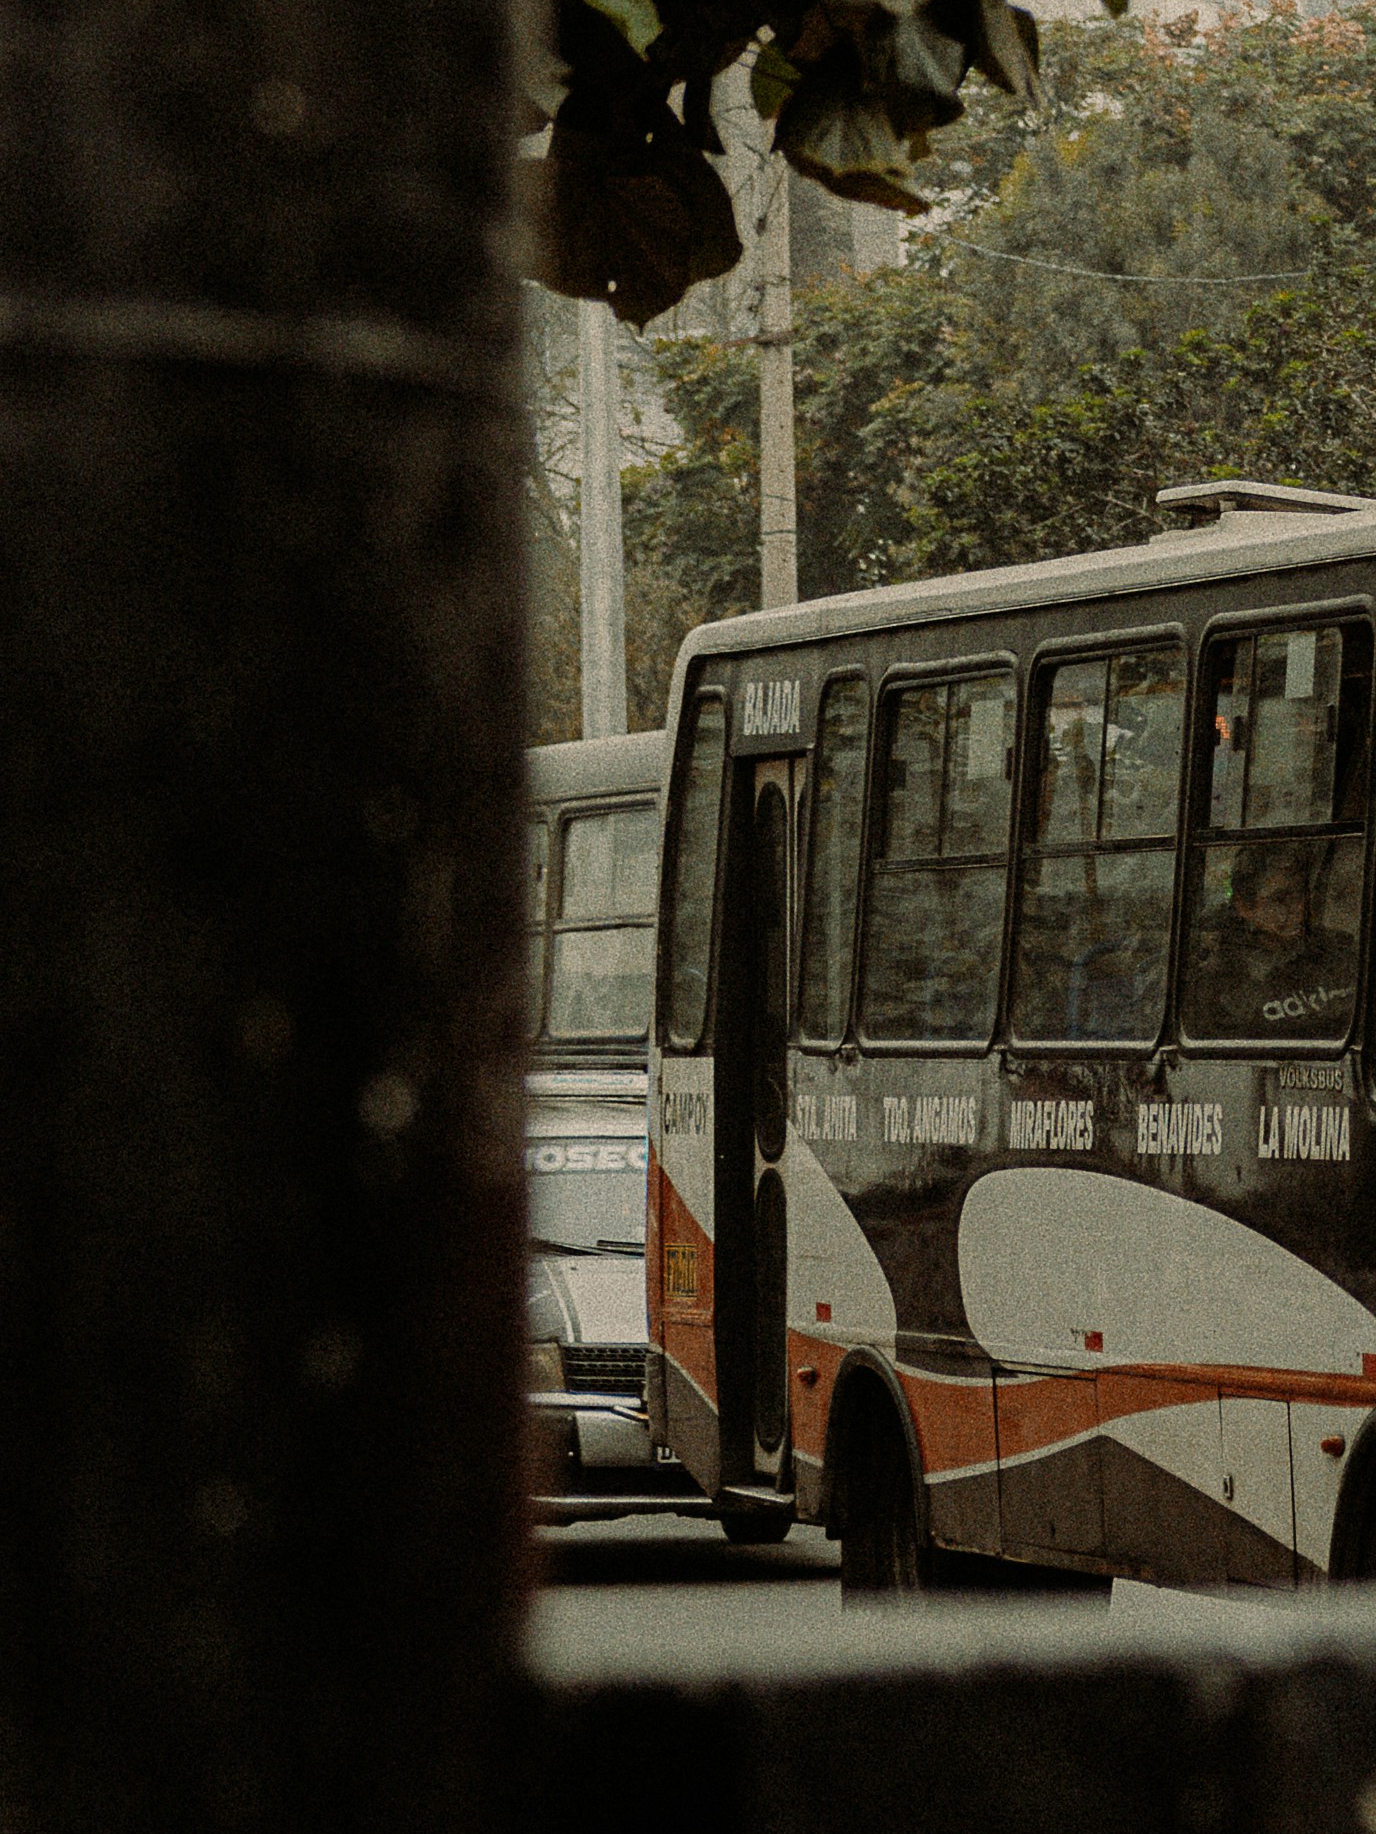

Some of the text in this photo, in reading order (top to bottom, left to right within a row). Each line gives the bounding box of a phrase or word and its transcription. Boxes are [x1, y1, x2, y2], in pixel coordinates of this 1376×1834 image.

[743, 680, 801, 736] BAJADA
[913, 1096, 976, 1146] ANGAMOS
[1008, 1100, 1095, 1151] MIRAFLORES
[1137, 1103, 1223, 1157] BENAVIDES
[1258, 1106, 1352, 1162] LA MOLINA
